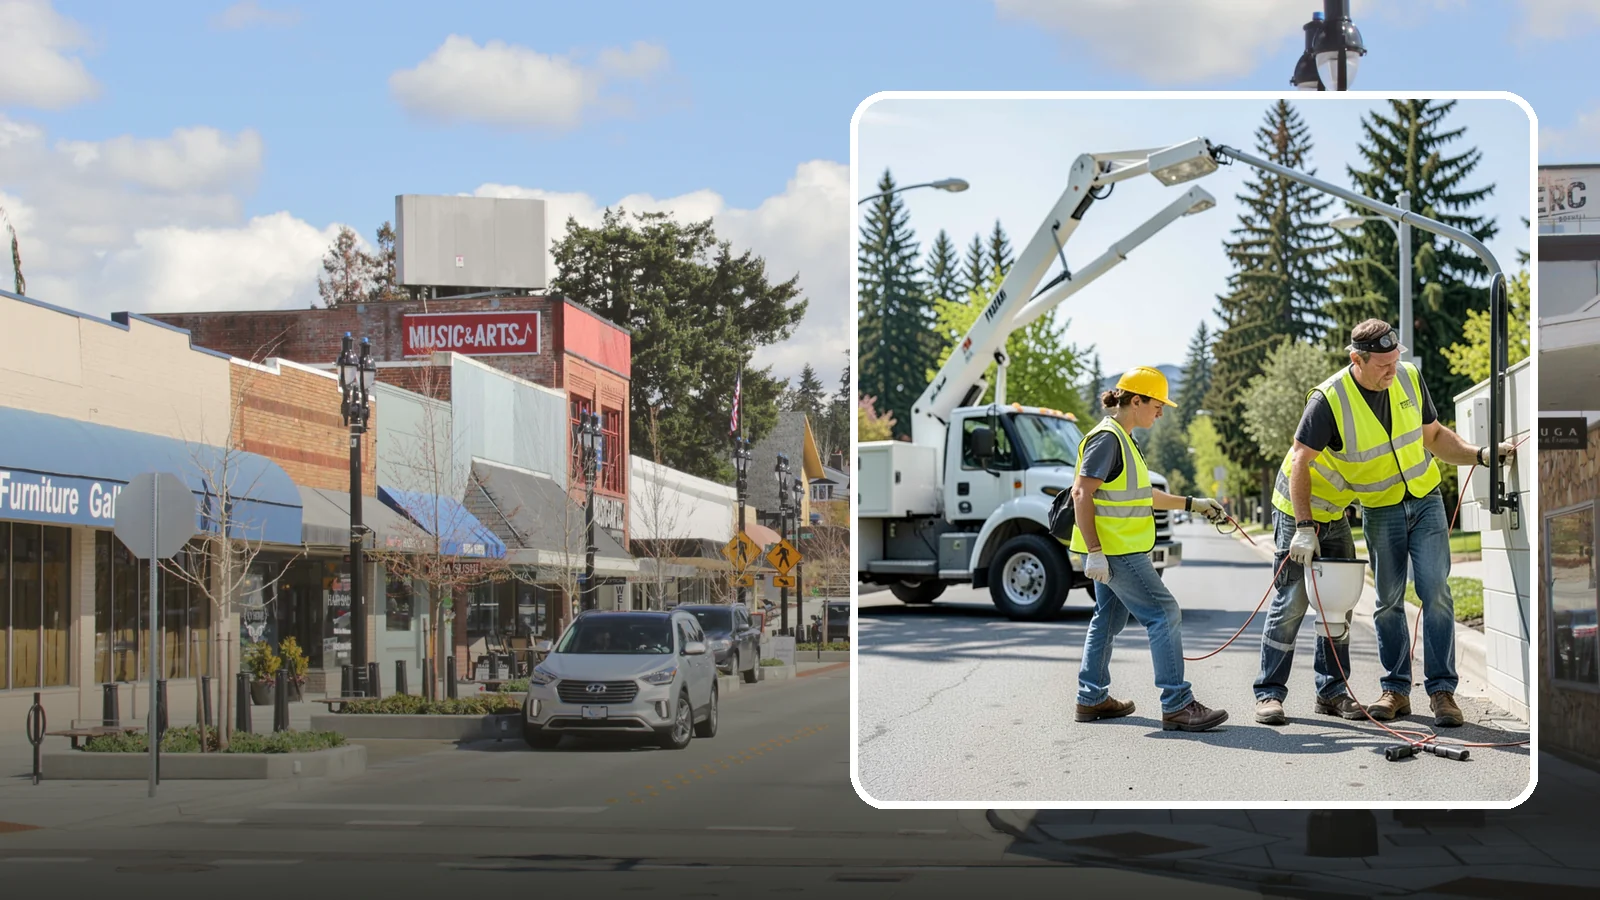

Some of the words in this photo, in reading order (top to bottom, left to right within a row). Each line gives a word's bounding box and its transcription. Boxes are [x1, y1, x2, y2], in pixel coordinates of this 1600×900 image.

[408, 322, 520, 349] MUSIC&ARTS
[0, 471, 79, 515] Furniture
[89, 482, 122, 519] Gal
[453, 563, 479, 574] SUSHI
